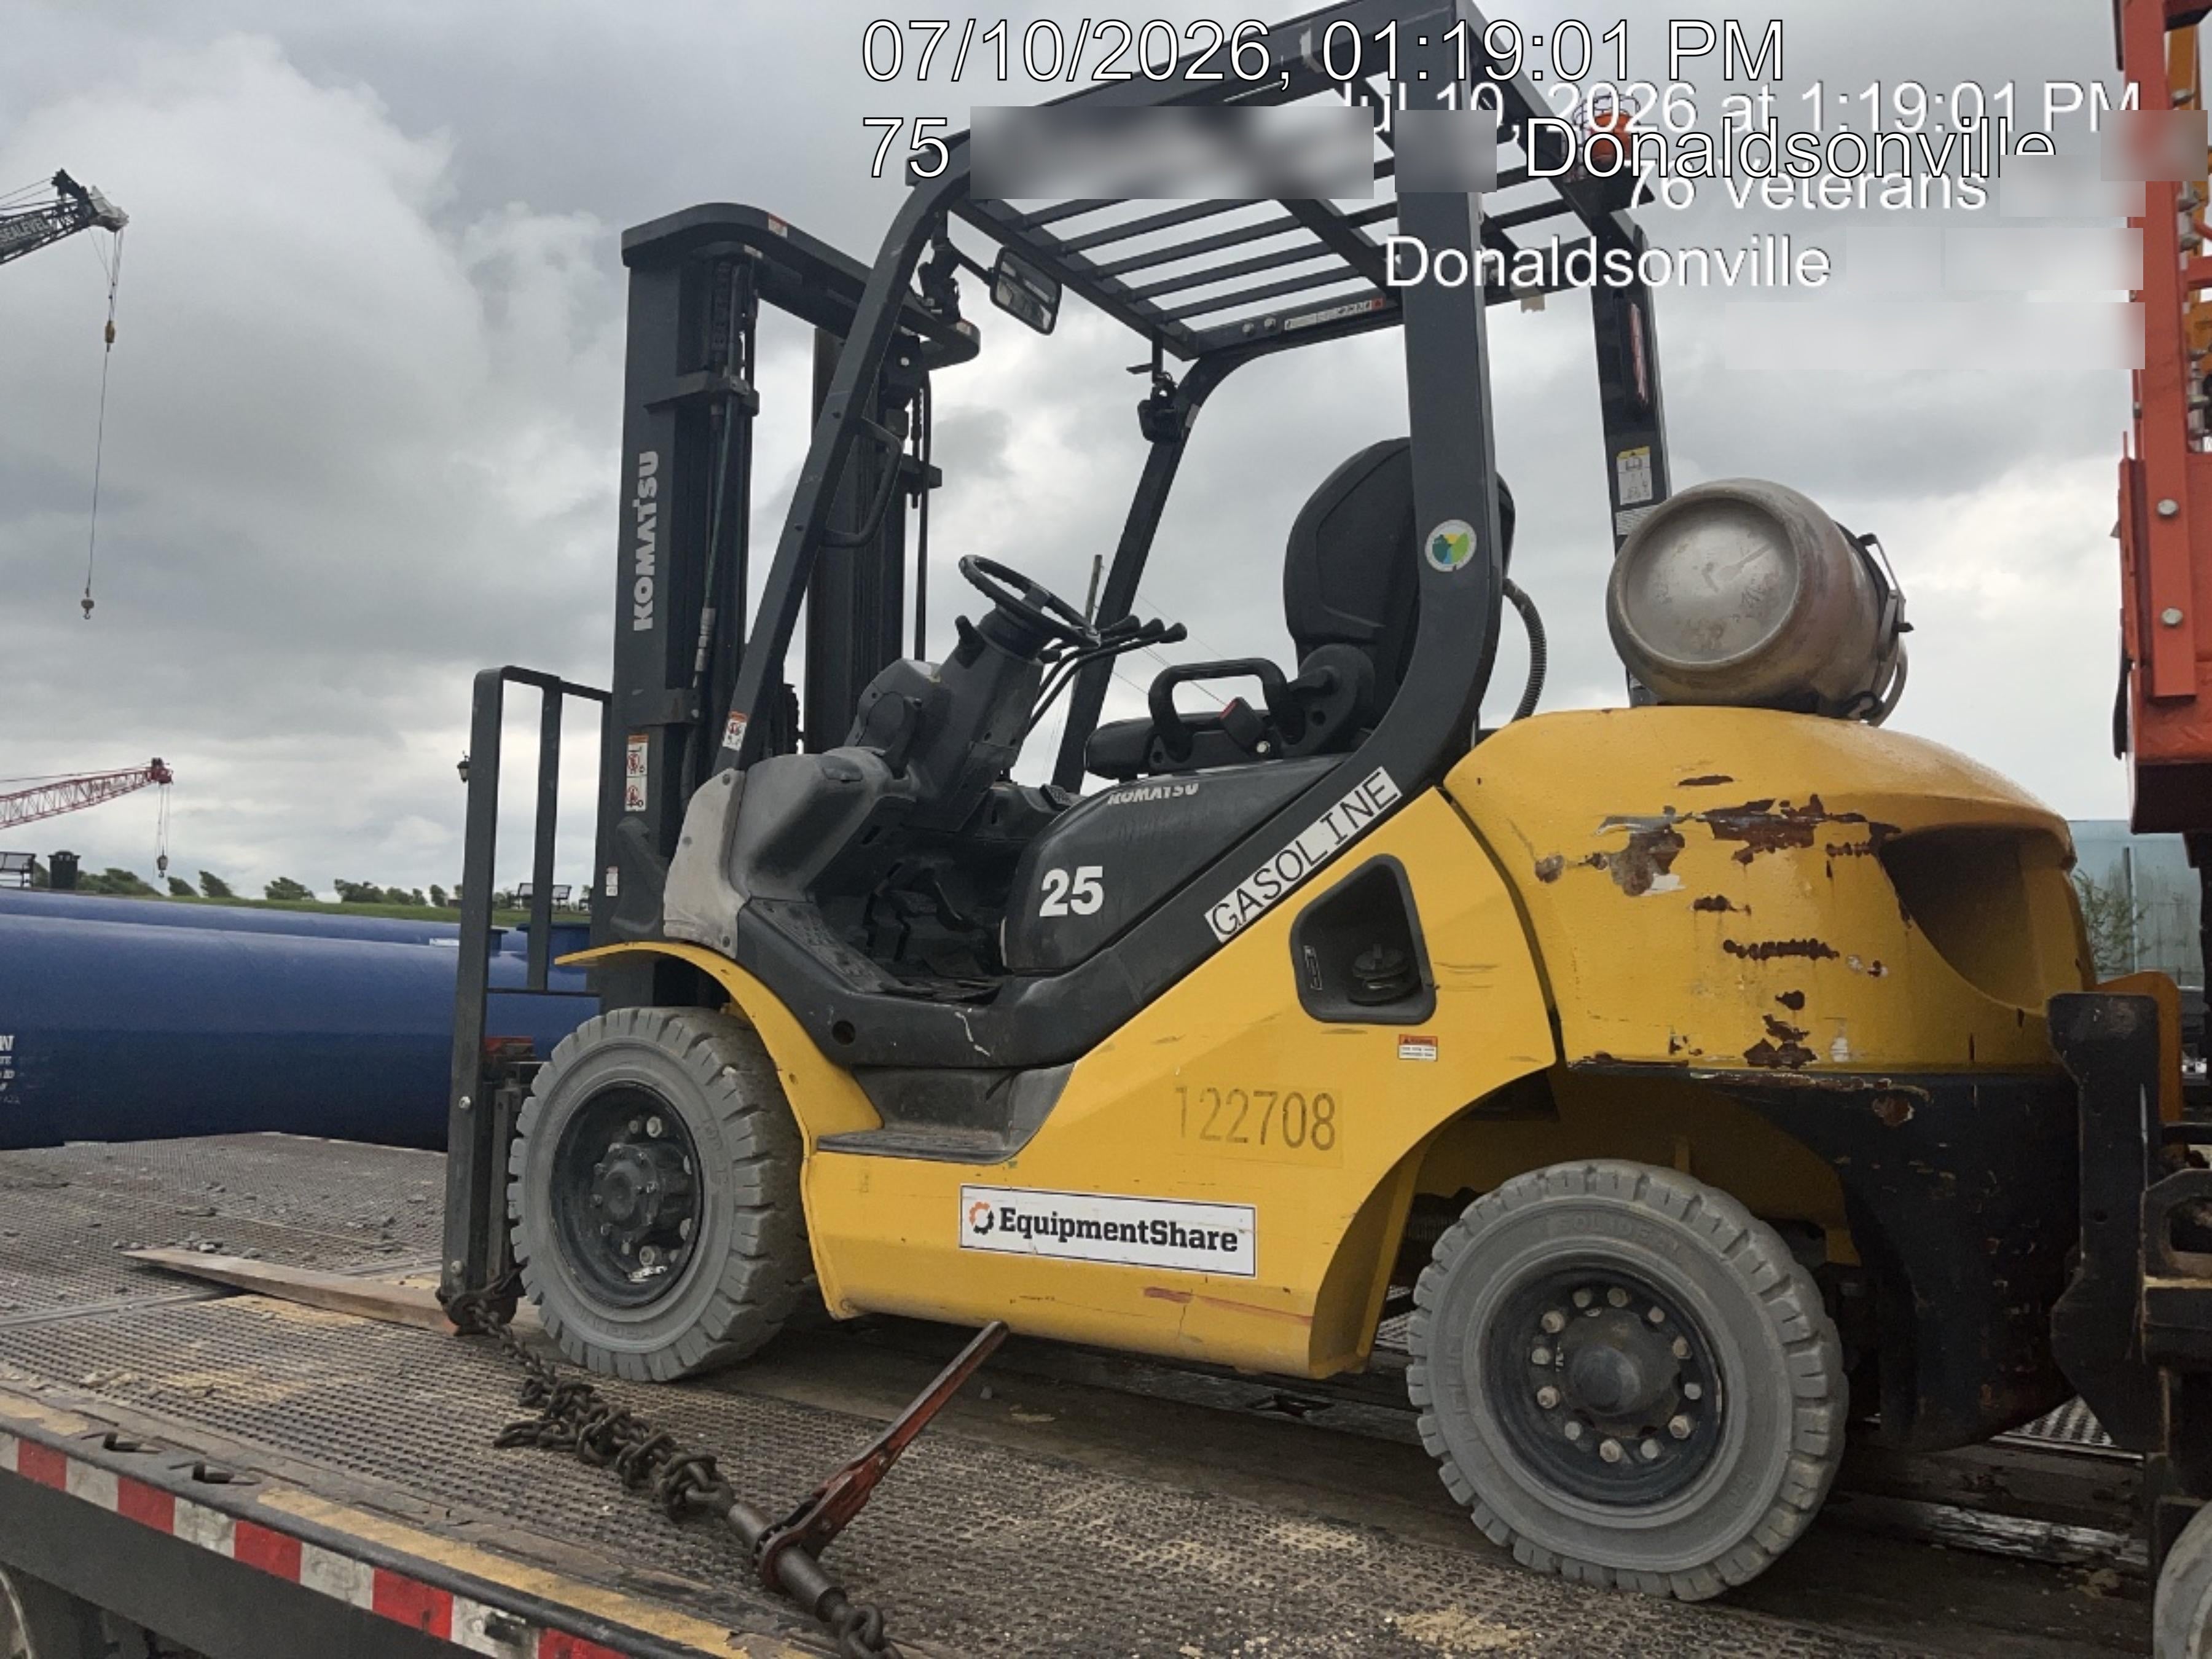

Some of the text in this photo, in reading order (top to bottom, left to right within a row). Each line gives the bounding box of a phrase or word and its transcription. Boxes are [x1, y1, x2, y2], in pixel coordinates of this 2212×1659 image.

[632, 451, 659, 632] KOMATSU
[1209, 770, 1398, 938] GASOLINE
[1039, 866, 1104, 917] 25
[1175, 1086, 1337, 1151] 122708
[999, 1206, 1238, 1253] EquipmentShare
